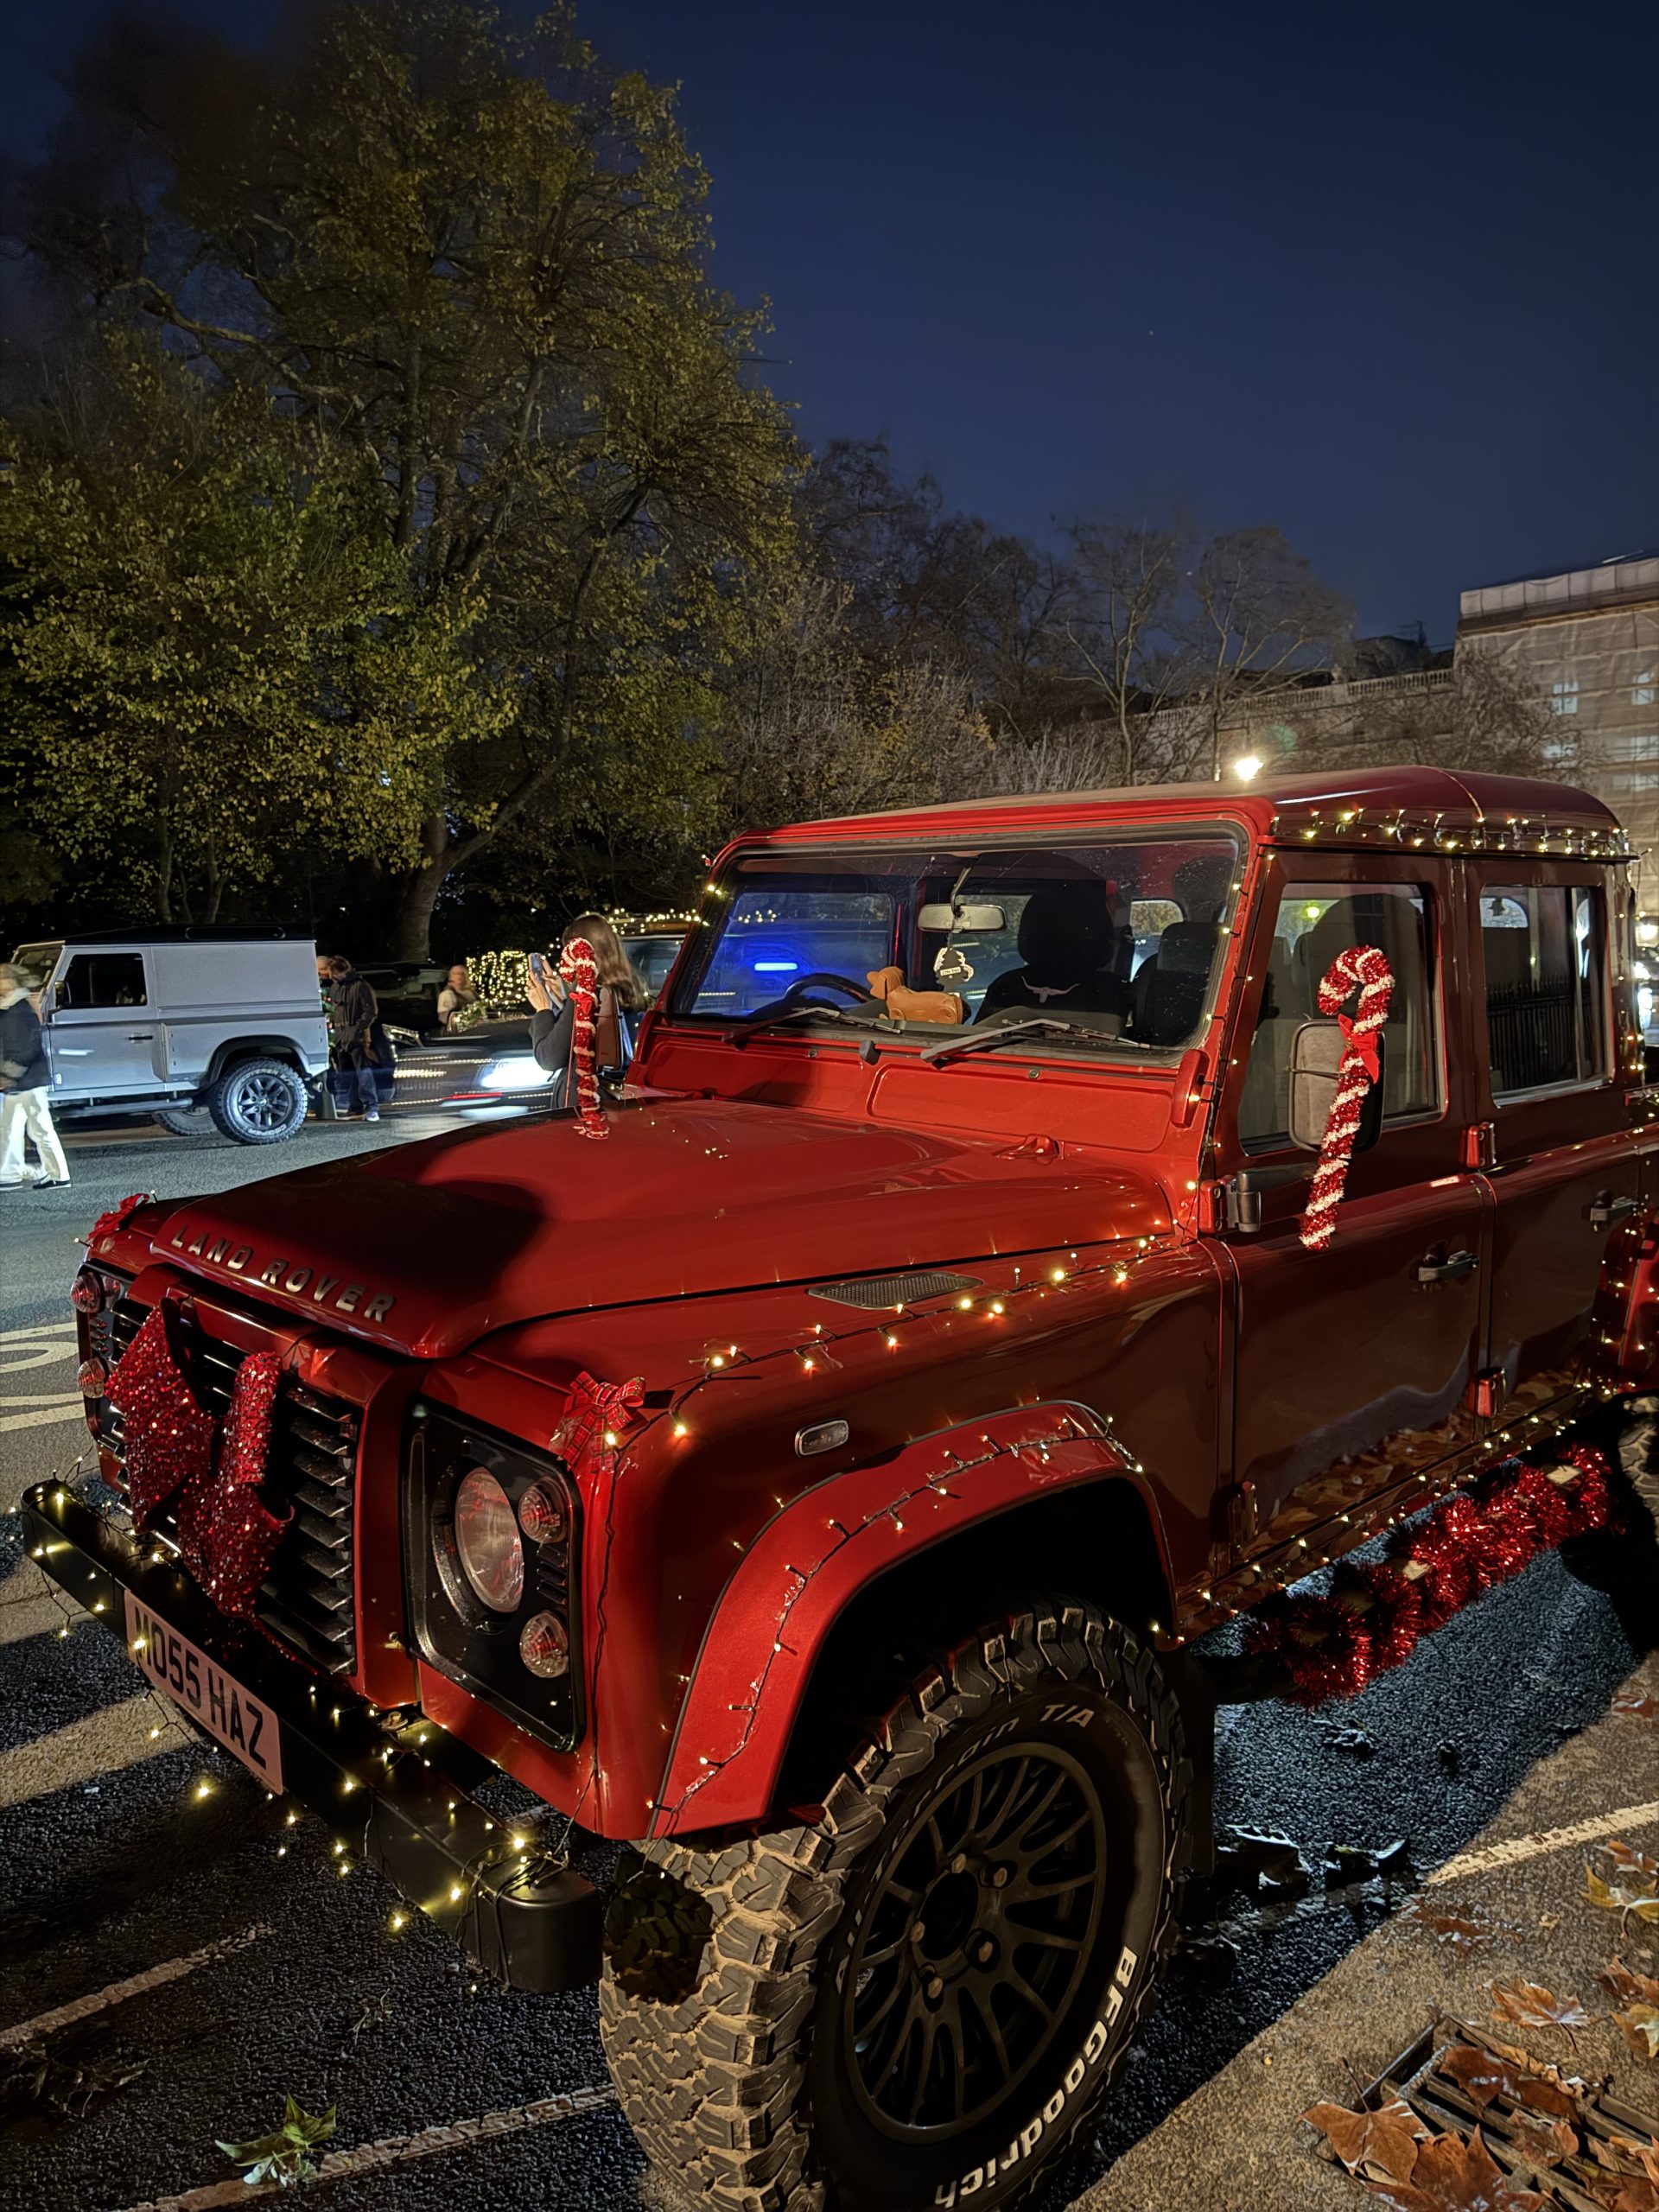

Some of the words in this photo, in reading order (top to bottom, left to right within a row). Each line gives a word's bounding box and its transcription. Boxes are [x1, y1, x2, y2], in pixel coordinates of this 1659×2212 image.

[171, 1224, 253, 1270] LAND
[261, 1258, 396, 1323] ROVER
[134, 1605, 201, 1711] MO55
[207, 1666, 267, 1770] HAZ
[1039, 1704, 1095, 1728] T/A
[935, 1945, 1138, 2209] BFGoodrich
